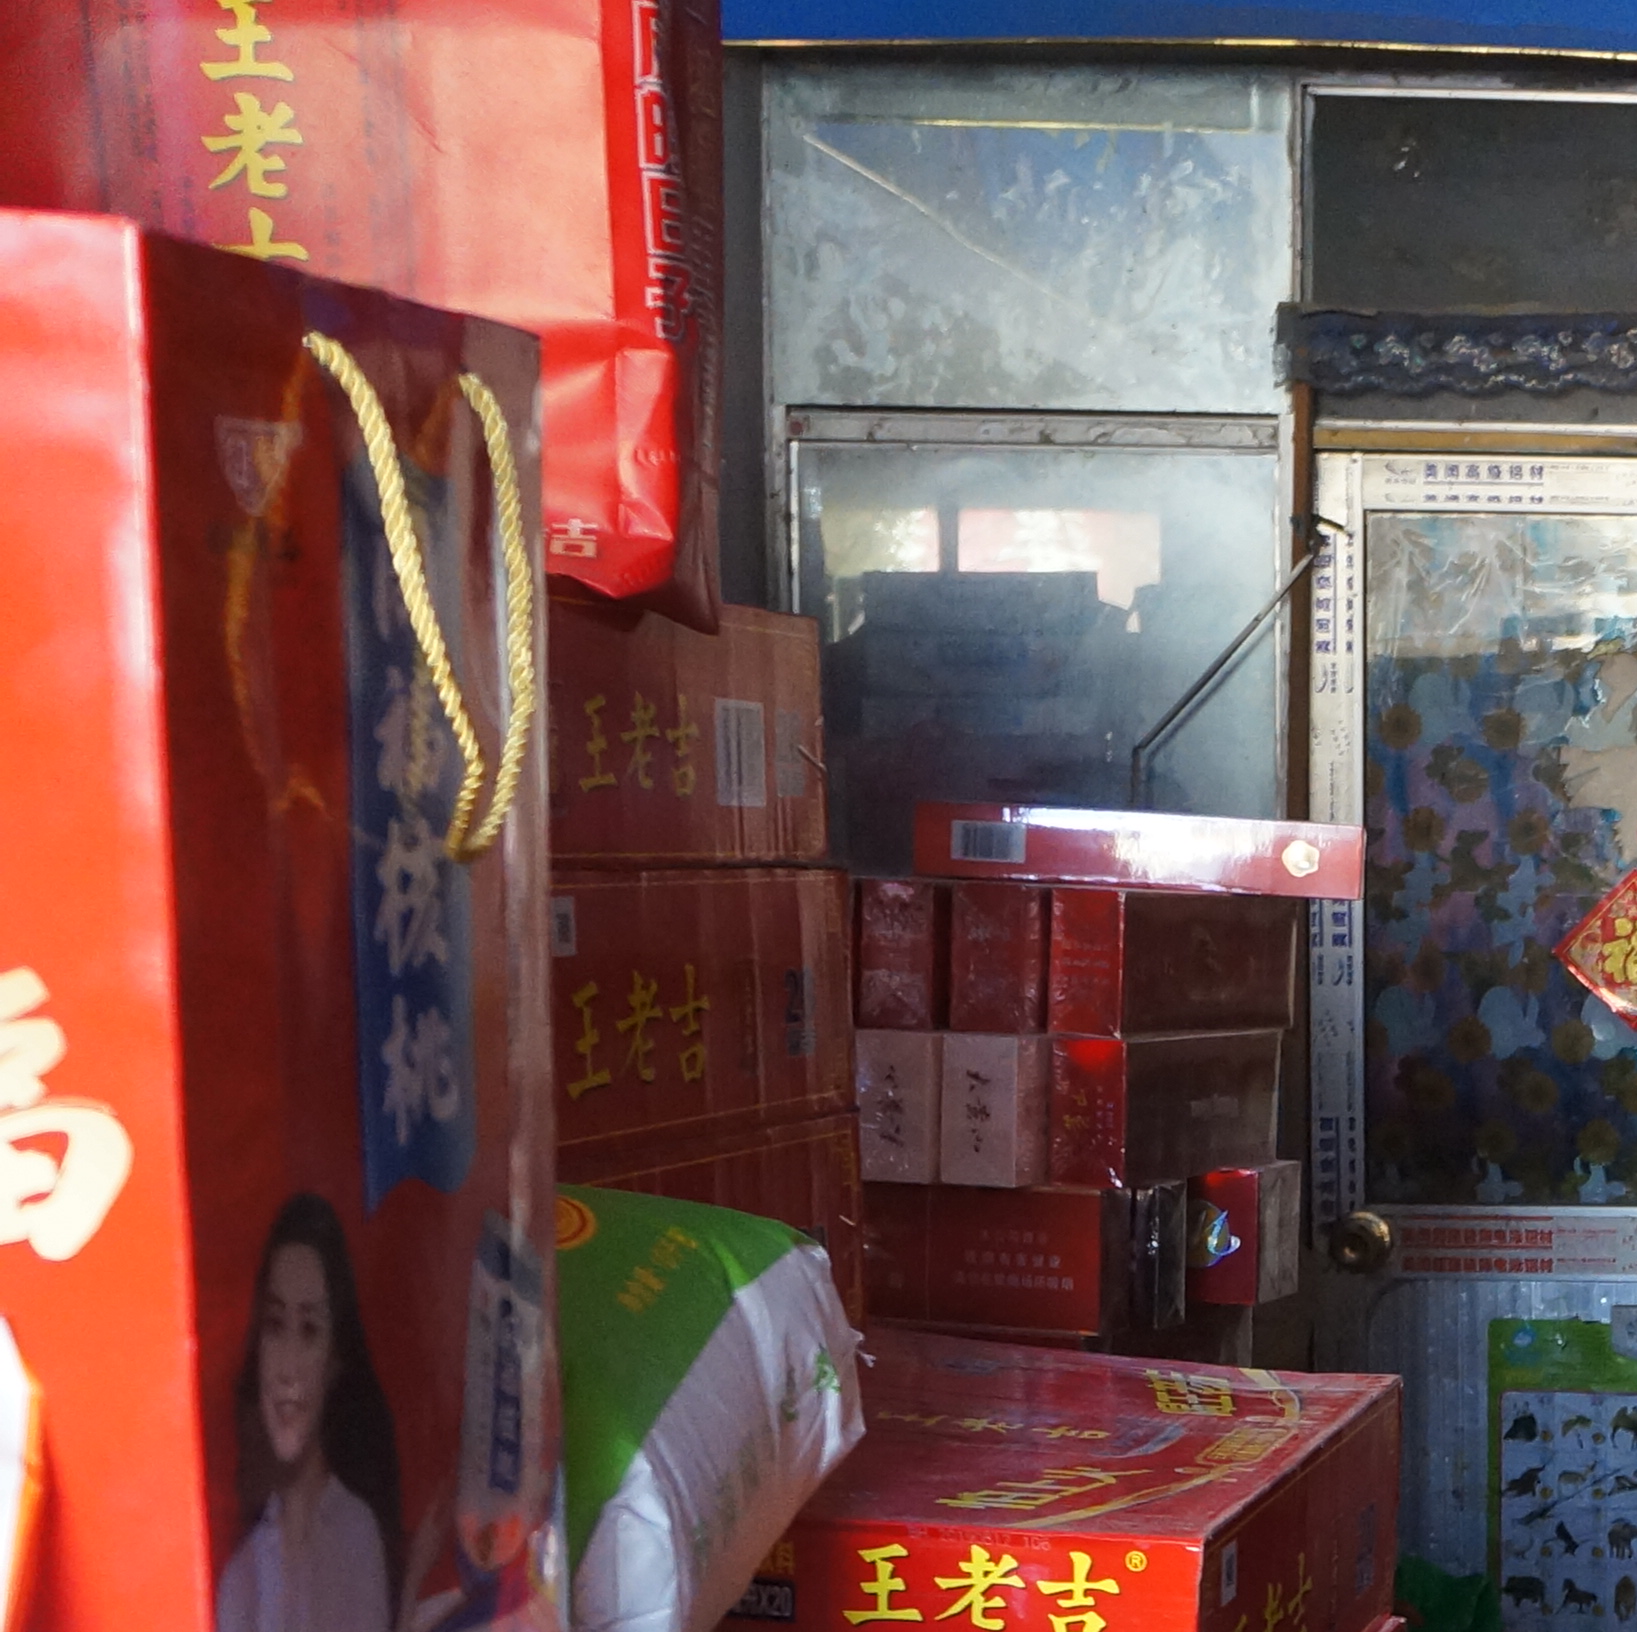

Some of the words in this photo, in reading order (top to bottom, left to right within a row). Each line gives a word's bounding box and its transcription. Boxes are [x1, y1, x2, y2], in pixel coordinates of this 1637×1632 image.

[578, 693, 698, 796] 王老吉
[567, 963, 711, 1099] 王老吉
